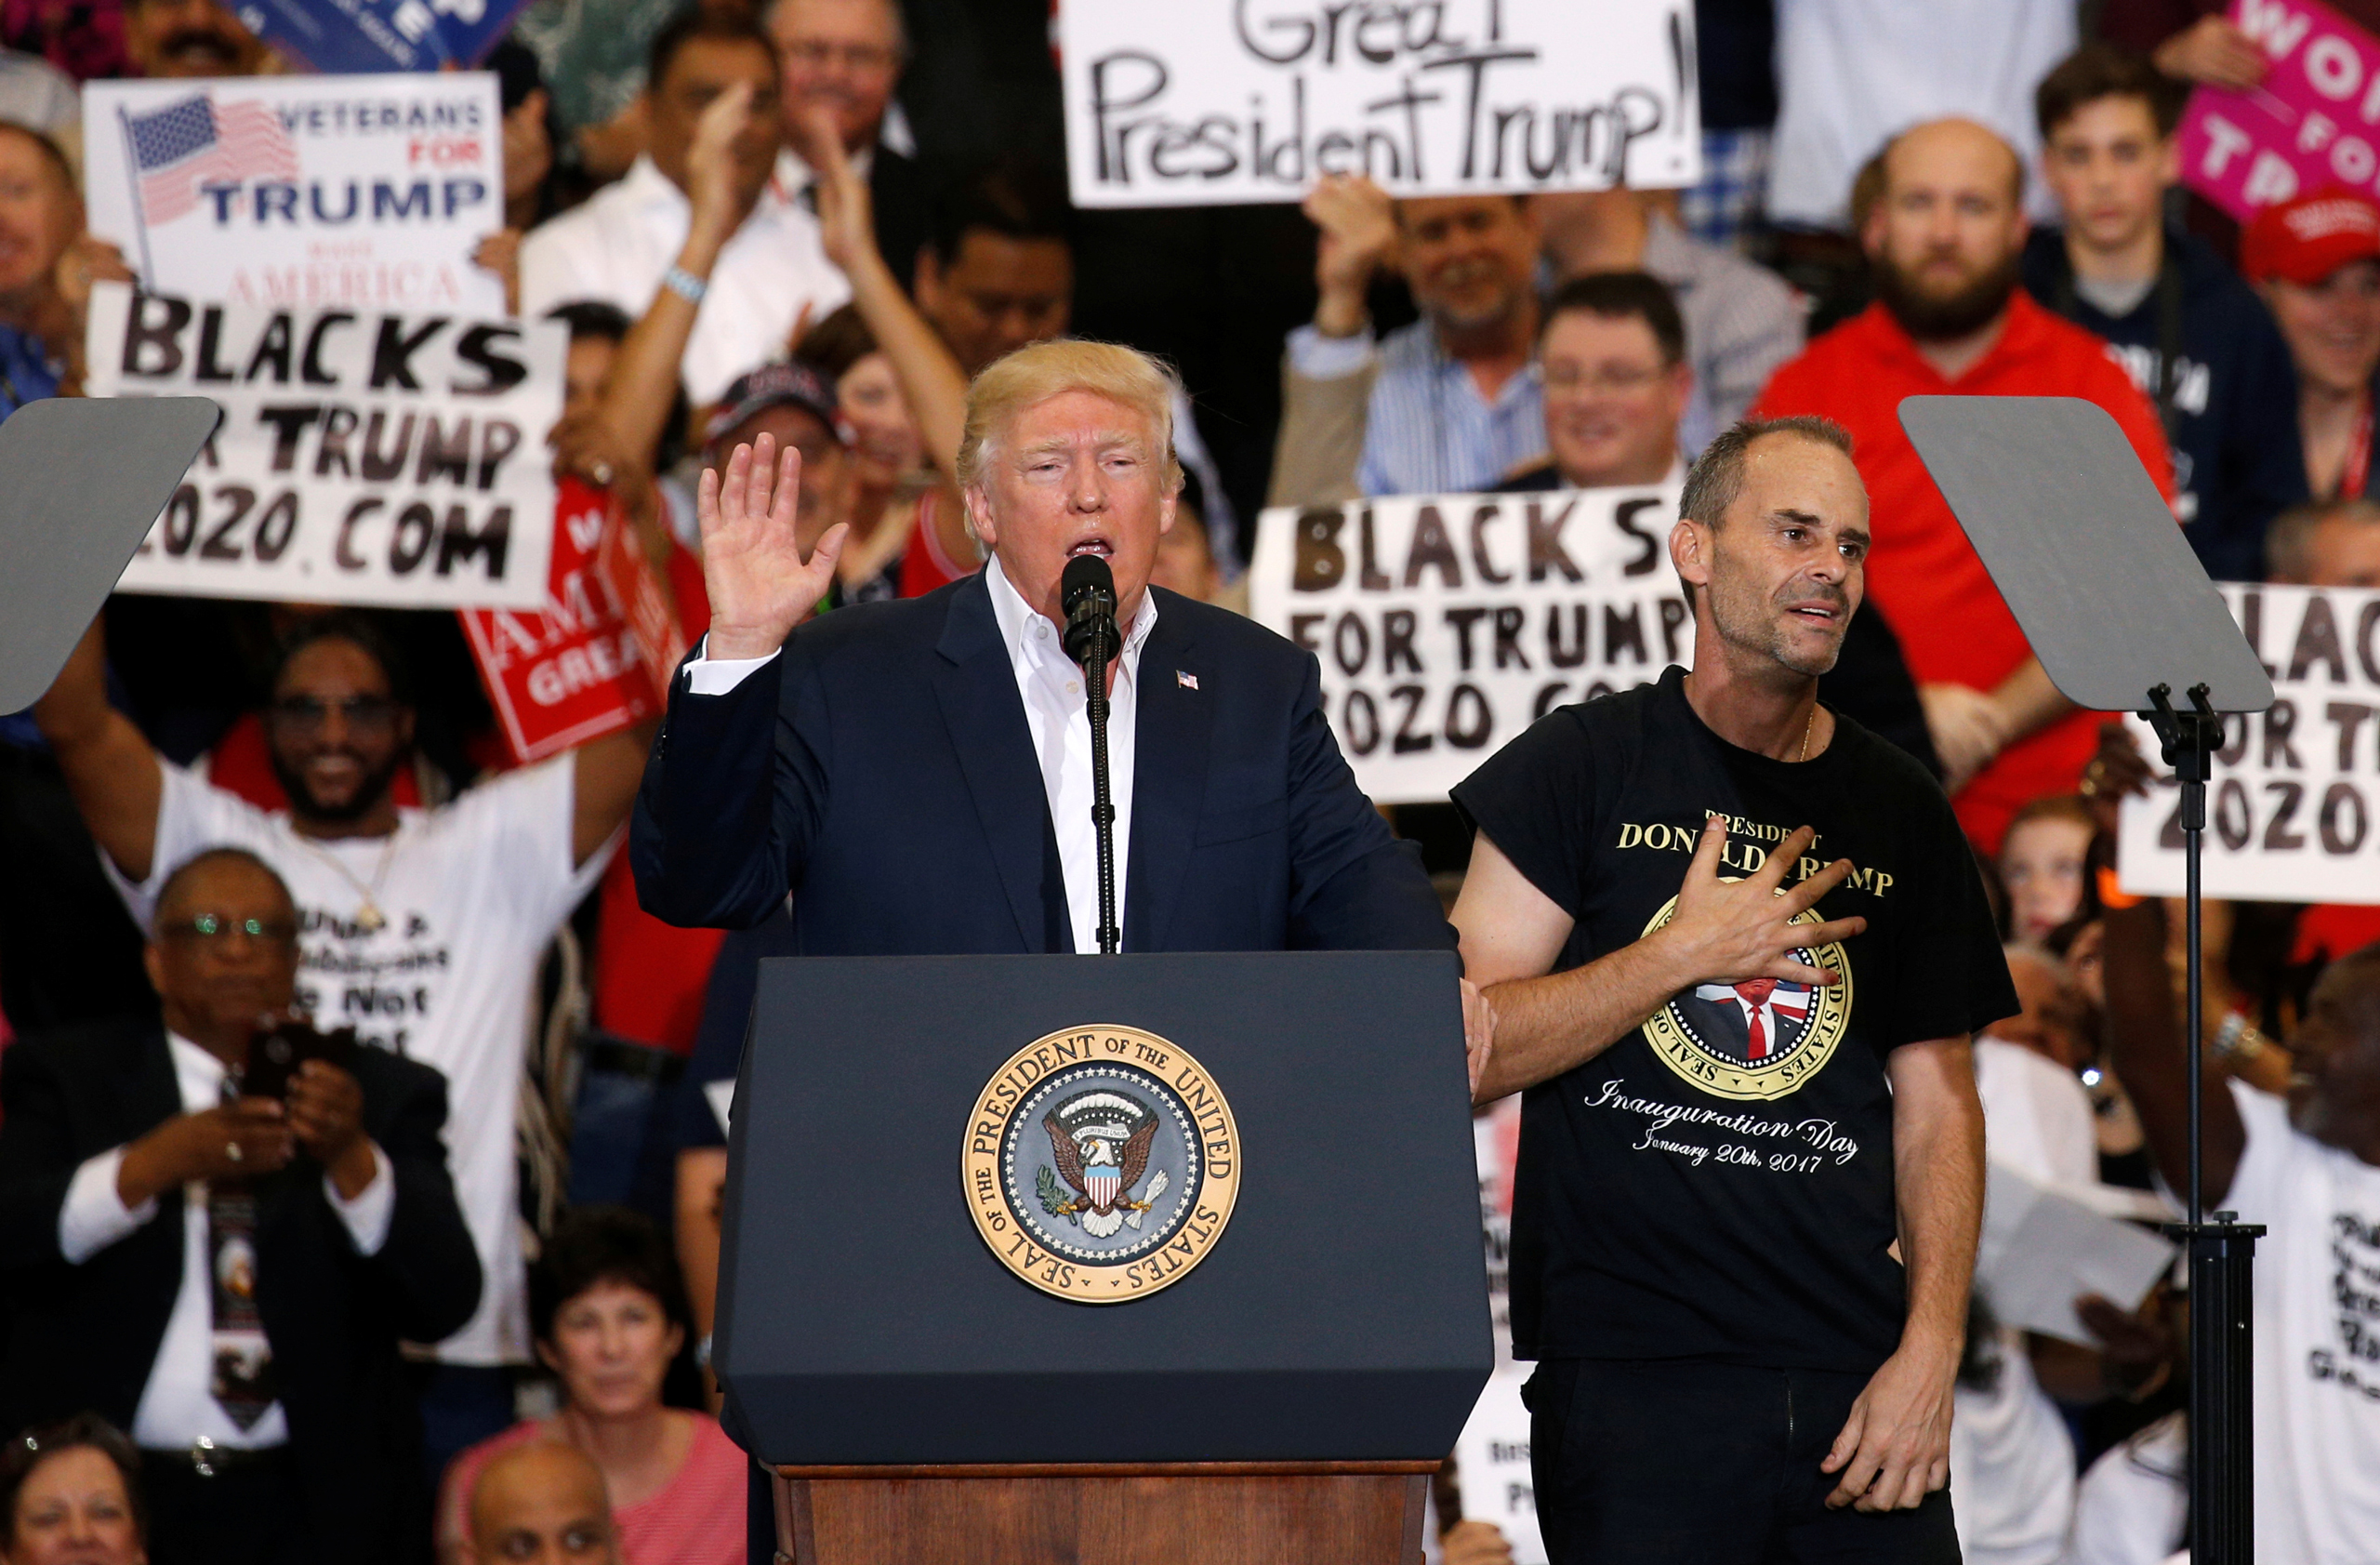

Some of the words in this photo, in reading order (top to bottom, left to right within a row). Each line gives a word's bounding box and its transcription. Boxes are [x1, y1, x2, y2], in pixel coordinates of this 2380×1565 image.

[281, 99, 483, 132] VETERANS
[1090, 50, 1444, 185] President
[408, 141, 482, 166] FOR
[200, 179, 487, 225] TRUMP
[228, 262, 461, 309] AMERICA
[121, 293, 528, 397] BLACKS
[258, 405, 521, 491] TRUMP
[1293, 497, 1662, 591] BLACKS
[1290, 610, 1422, 677] FOR
[1445, 597, 1688, 671] TRUMP
[1320, 683, 1492, 756] 020
[1616, 823, 1766, 873] DONLD
[1104, 1037, 1130, 1054] OF
[1135, 1043, 1170, 1070] THE
[1668, 1036, 1718, 1081] SEAL
[1779, 1010, 1840, 1083] STATES
[972, 1034, 1095, 1156] PRESIDENT
[1174, 1066, 1232, 1180] UNITED
[1584, 1078, 1793, 1138] Inauguration
[1795, 1118, 1859, 1165] Day
[1633, 1128, 1710, 1166] January
[1714, 1144, 1763, 1167] 20th,
[1768, 1153, 1823, 1174] 2017
[975, 1167, 996, 1205] THE
[985, 1209, 1007, 1231] OF
[1125, 1203, 1220, 1290] STATES
[1006, 1230, 1077, 1289] SEAL
